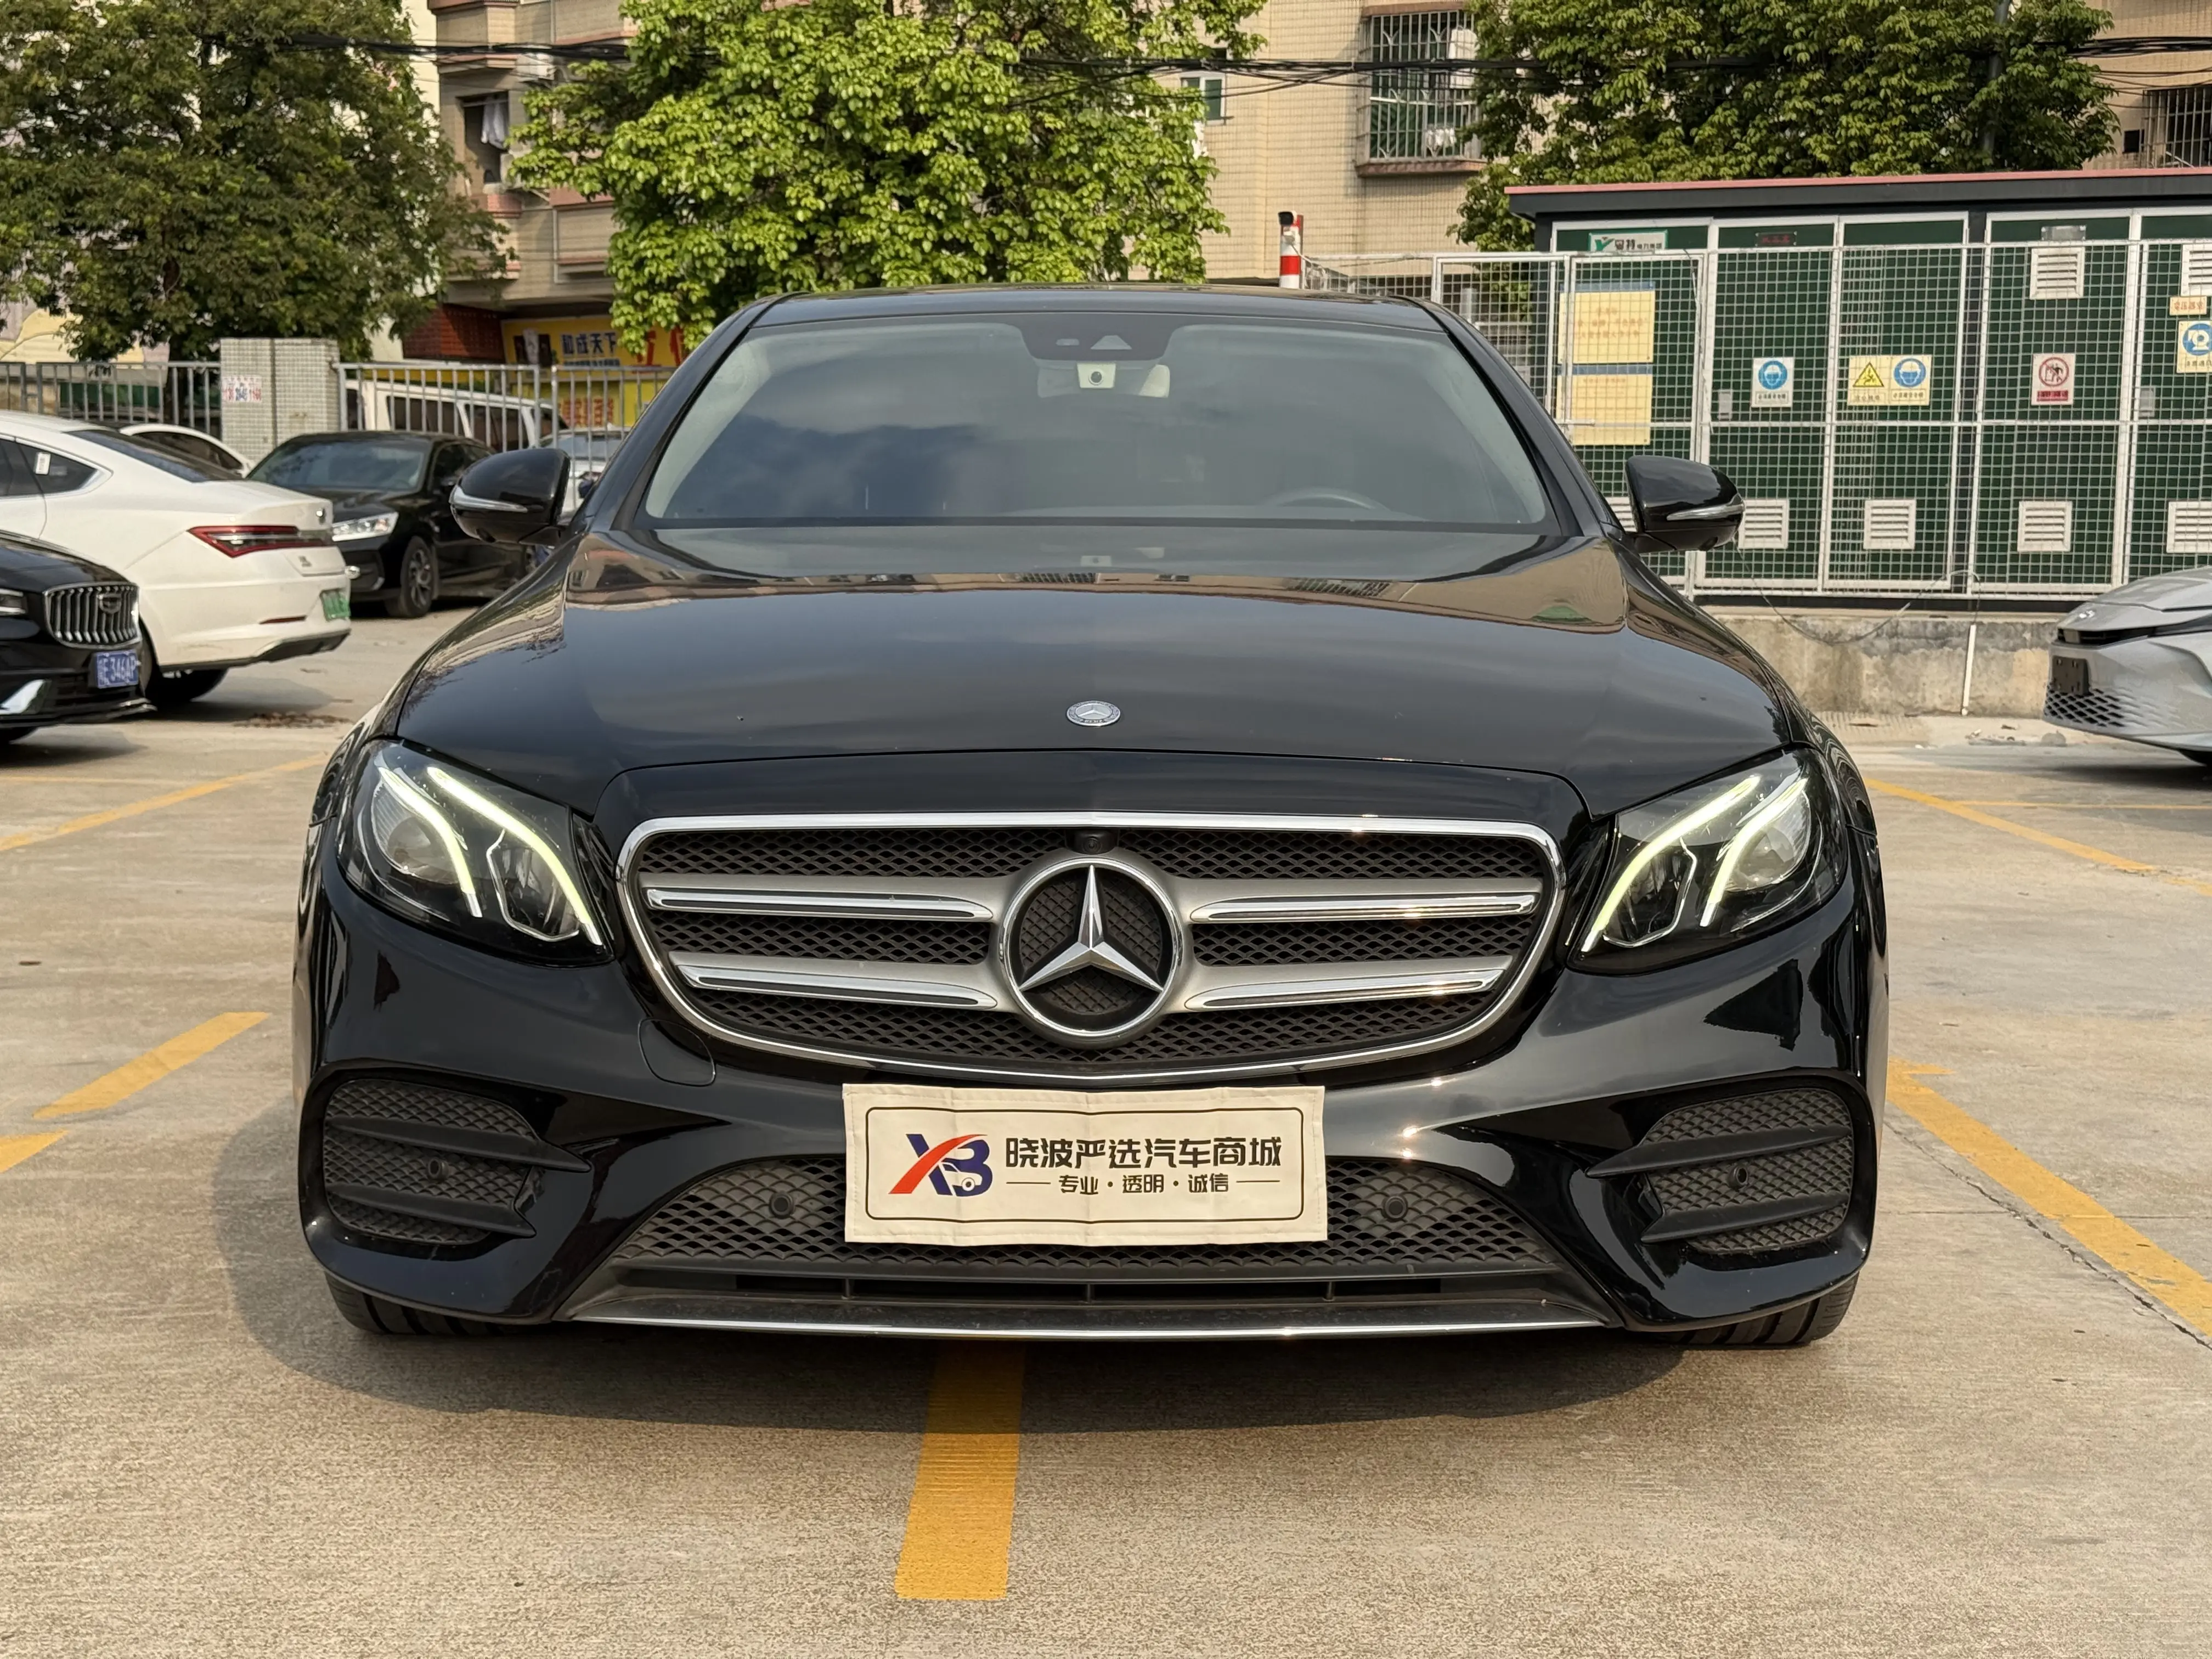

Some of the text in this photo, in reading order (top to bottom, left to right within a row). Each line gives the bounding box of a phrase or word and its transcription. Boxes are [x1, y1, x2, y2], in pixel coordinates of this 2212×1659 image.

[1006, 1136, 1282, 1169] 晓波严选汽车商城
